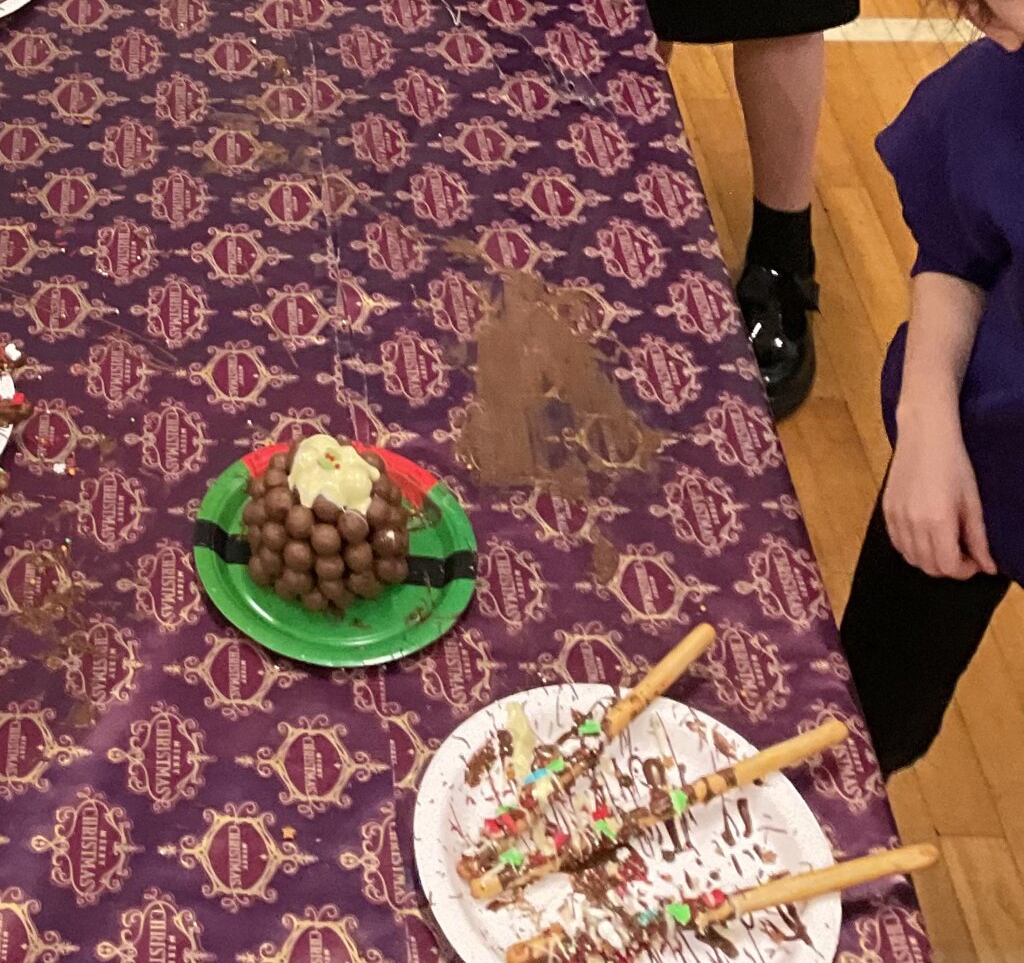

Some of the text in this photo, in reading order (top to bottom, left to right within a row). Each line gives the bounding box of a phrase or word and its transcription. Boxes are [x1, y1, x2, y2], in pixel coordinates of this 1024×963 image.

[109, 345, 123, 397] CHRISTMAS
[165, 413, 179, 469] CHRISTMAS
[101, 479, 116, 538] CHRISTMAS
[161, 554, 175, 618] CHRISTMAS
[155, 720, 171, 795] CHRISTMAS
[78, 808, 97, 888] CHRISTMAS
